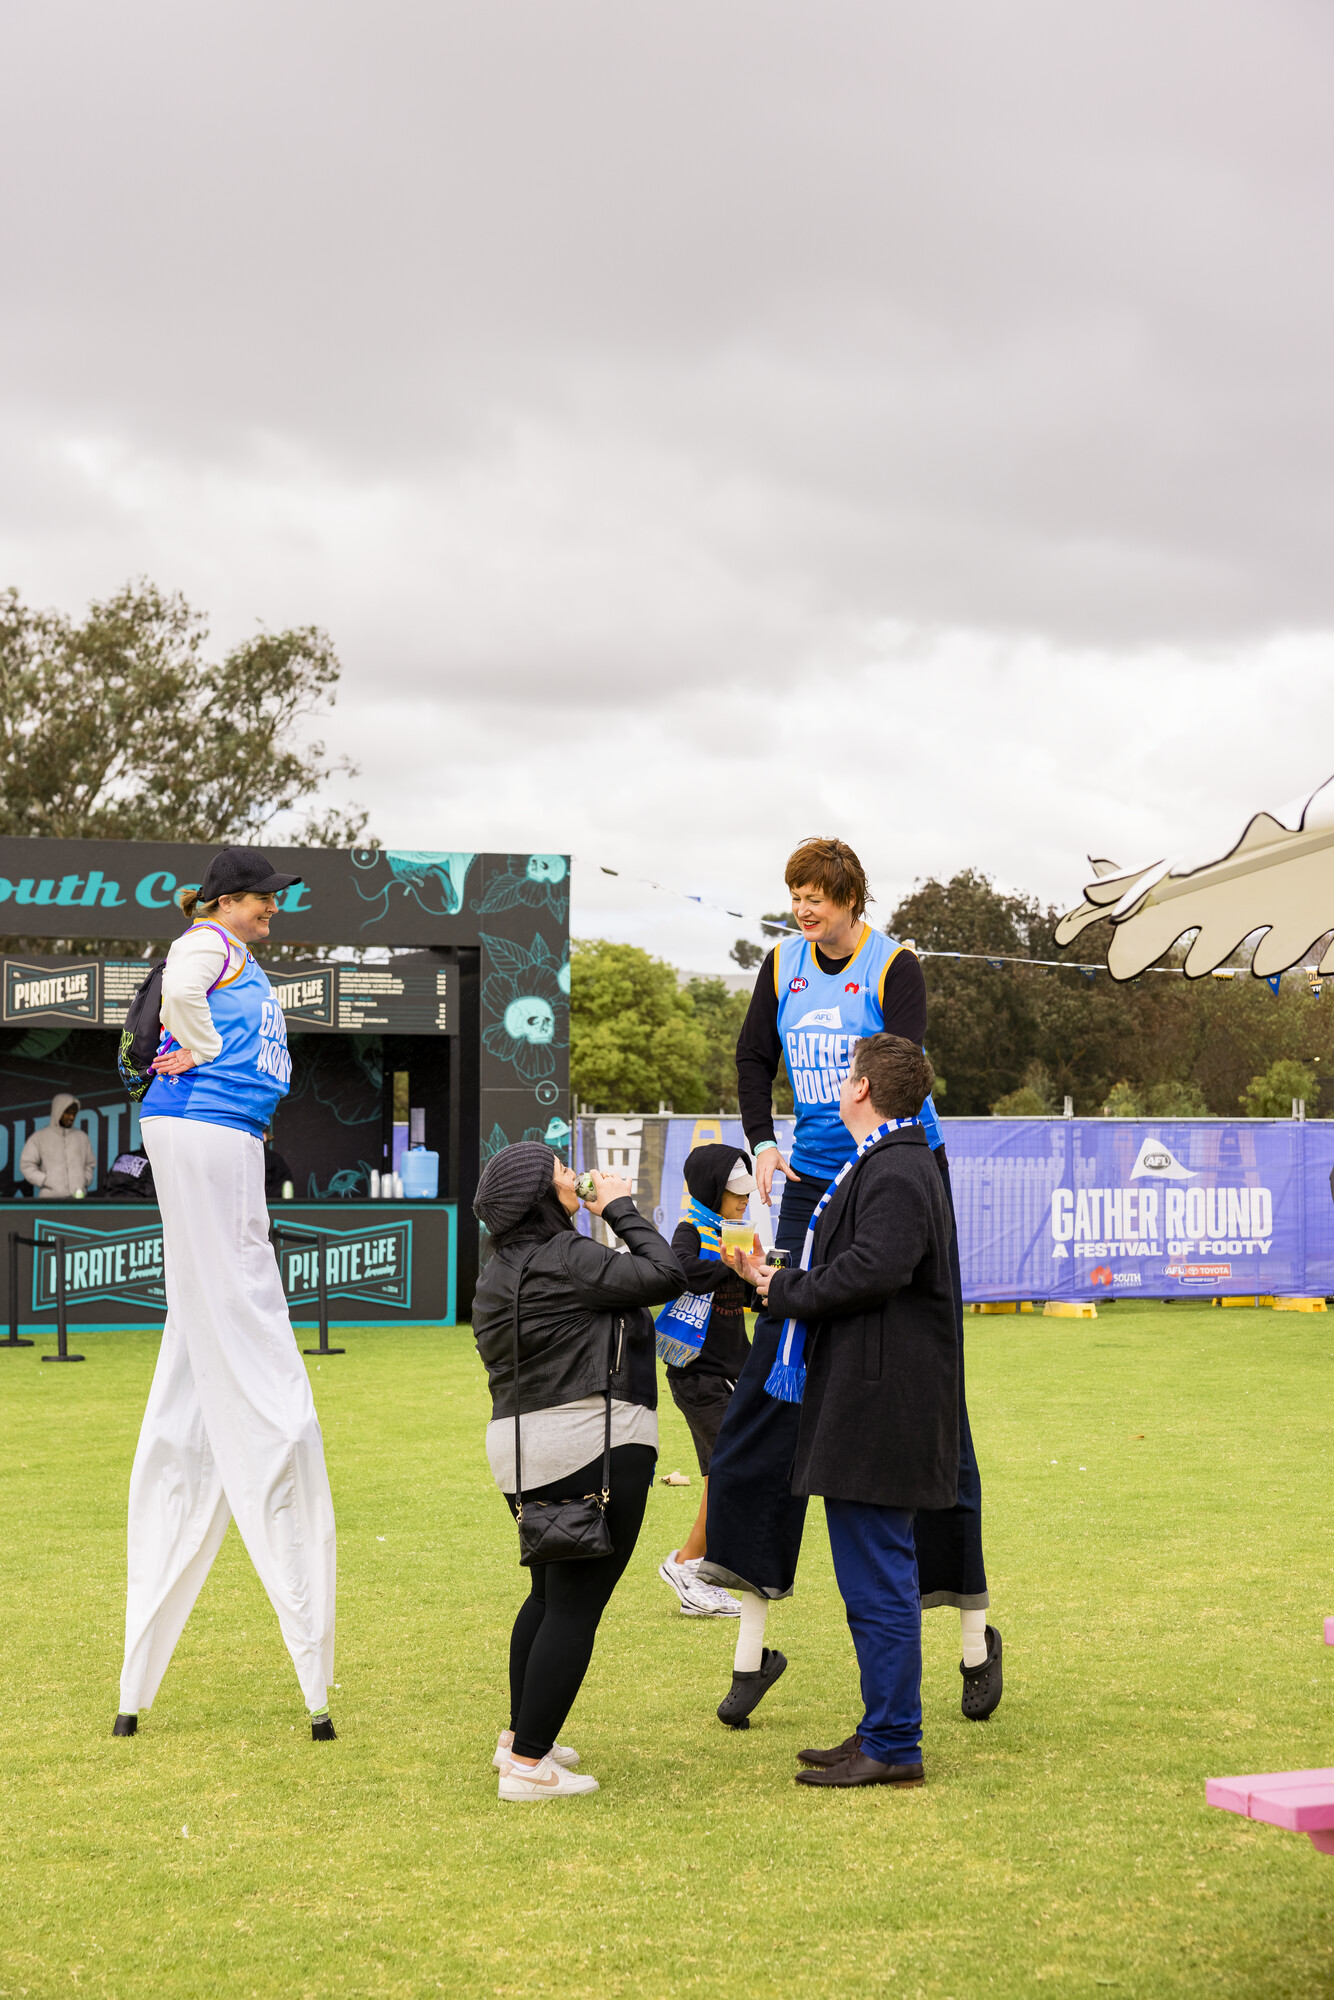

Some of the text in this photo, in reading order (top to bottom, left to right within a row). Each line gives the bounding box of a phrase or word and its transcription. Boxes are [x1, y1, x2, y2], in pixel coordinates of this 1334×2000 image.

[271, 982, 301, 1010] ATE
[814, 1013, 831, 1021] AFL
[1146, 1156, 1169, 1166] AFL
[1051, 1187, 1273, 1241] GATHER ROUND
[1051, 1240, 1273, 1258] A FESTIVAL OF FOOTY
[1113, 1272, 1141, 1282] SOUTH
[1166, 1266, 1229, 1275] AFL TOYOTA
[671, 1294, 712, 1320] ROUND
[667, 1309, 704, 1329] 2026
